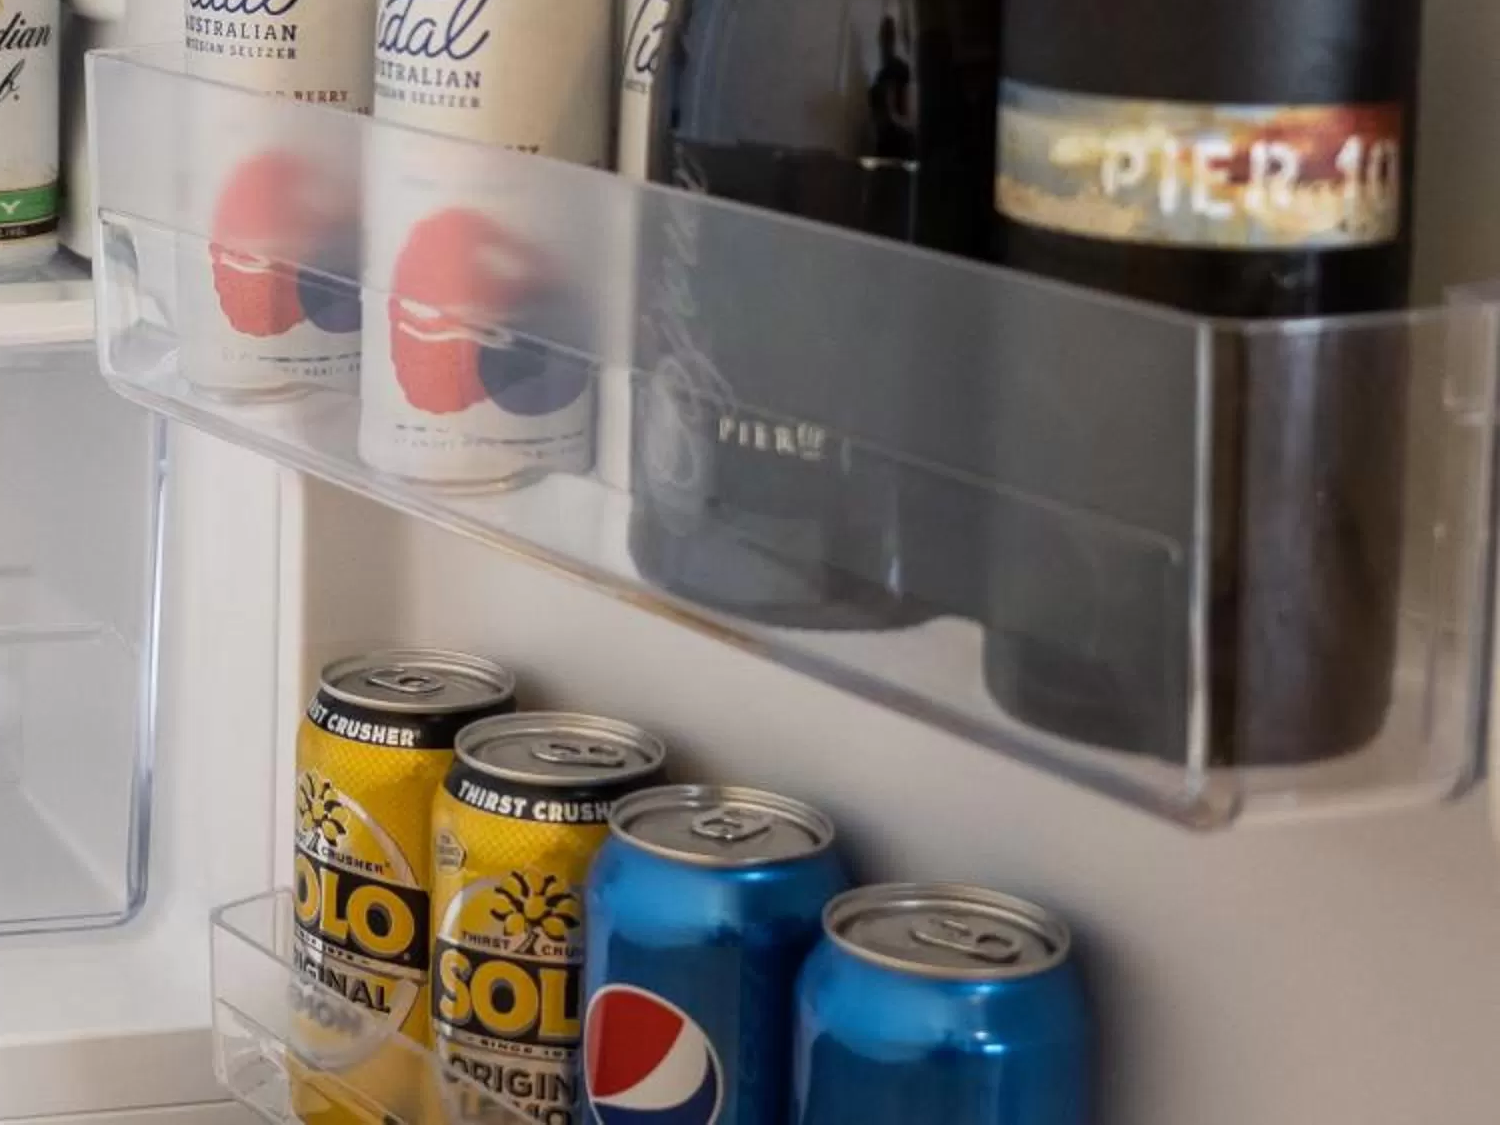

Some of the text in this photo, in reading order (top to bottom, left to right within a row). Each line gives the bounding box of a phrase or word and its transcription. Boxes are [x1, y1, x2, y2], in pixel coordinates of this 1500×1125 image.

[1101, 131, 1398, 220] PIER 10
[327, 713, 415, 747] CRUSHER
[458, 779, 527, 818] THIRST
[321, 847, 384, 873] CRUSHER
[462, 931, 510, 950] THIRST
[440, 949, 581, 1037] SOL
